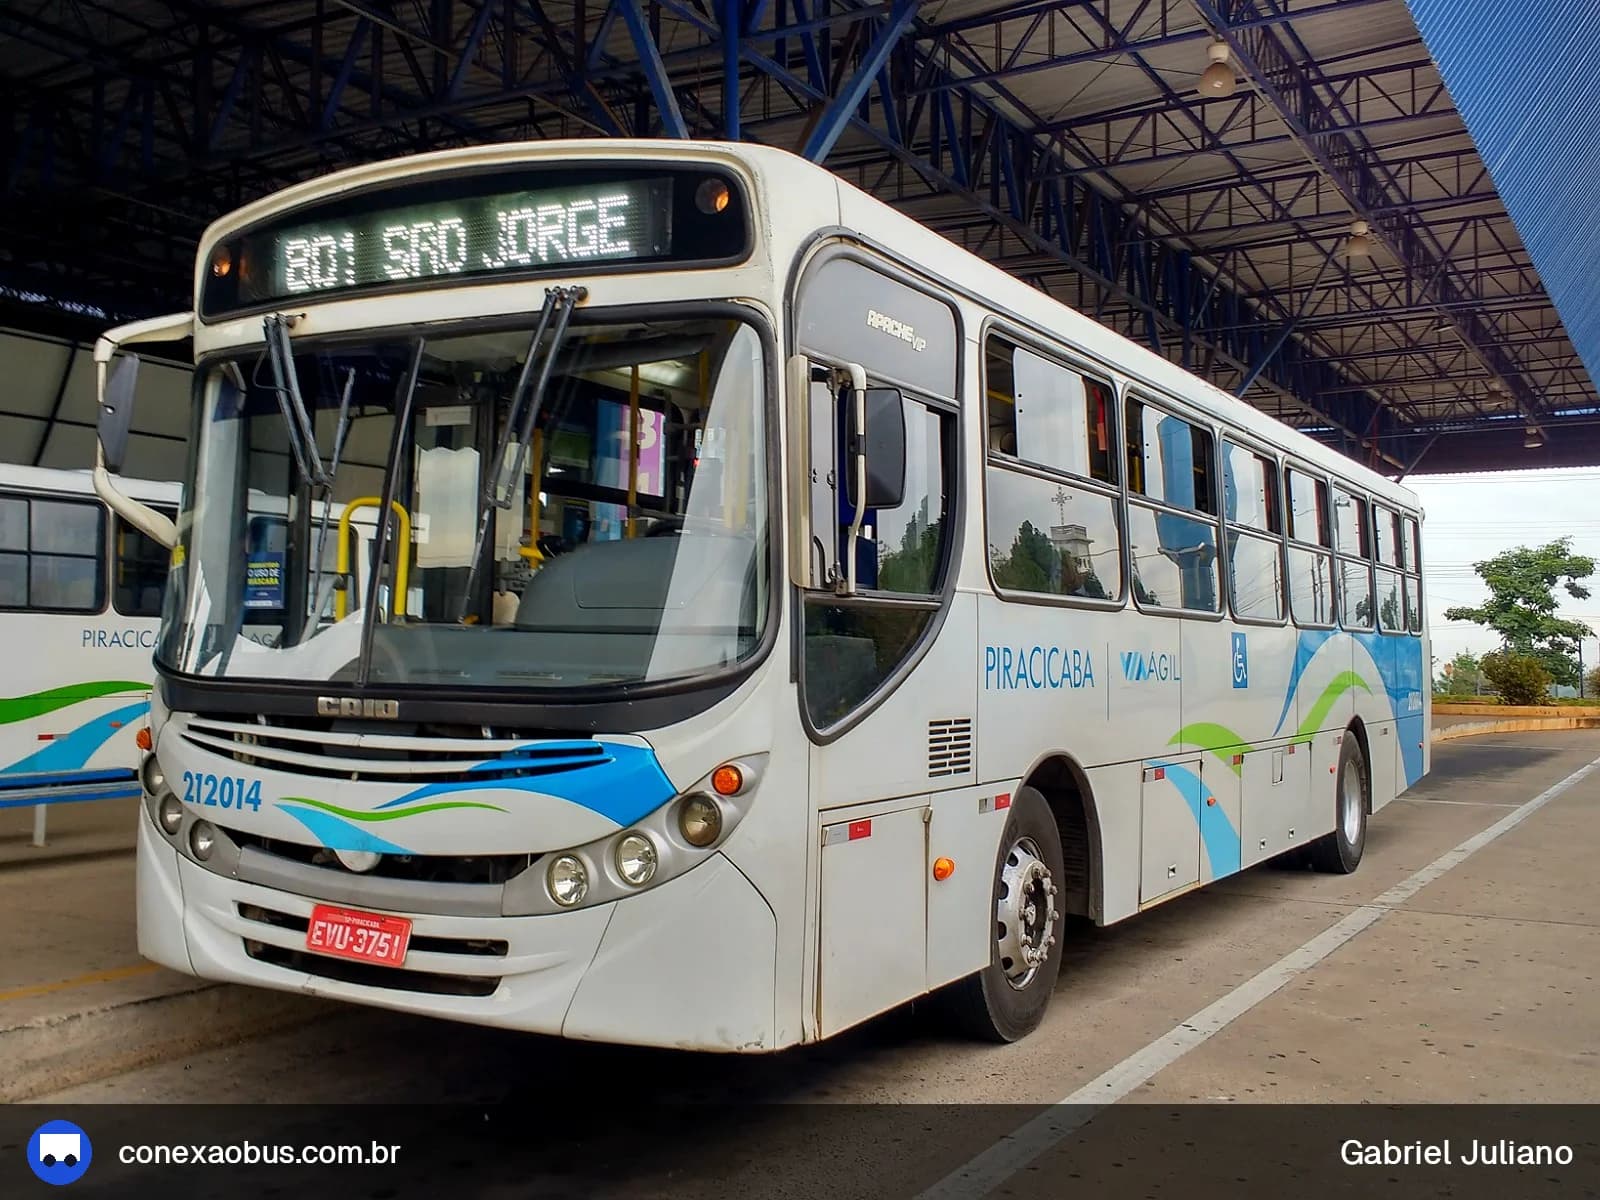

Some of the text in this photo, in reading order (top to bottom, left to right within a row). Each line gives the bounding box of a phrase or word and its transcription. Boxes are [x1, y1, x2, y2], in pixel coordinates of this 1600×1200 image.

[284, 232, 356, 291] 801
[481, 193, 631, 269] JORGE
[866, 308, 914, 343] APACHE
[985, 646, 1095, 690] PIRACICABA
[317, 696, 399, 719] CAIO
[183, 770, 262, 812] 212014
